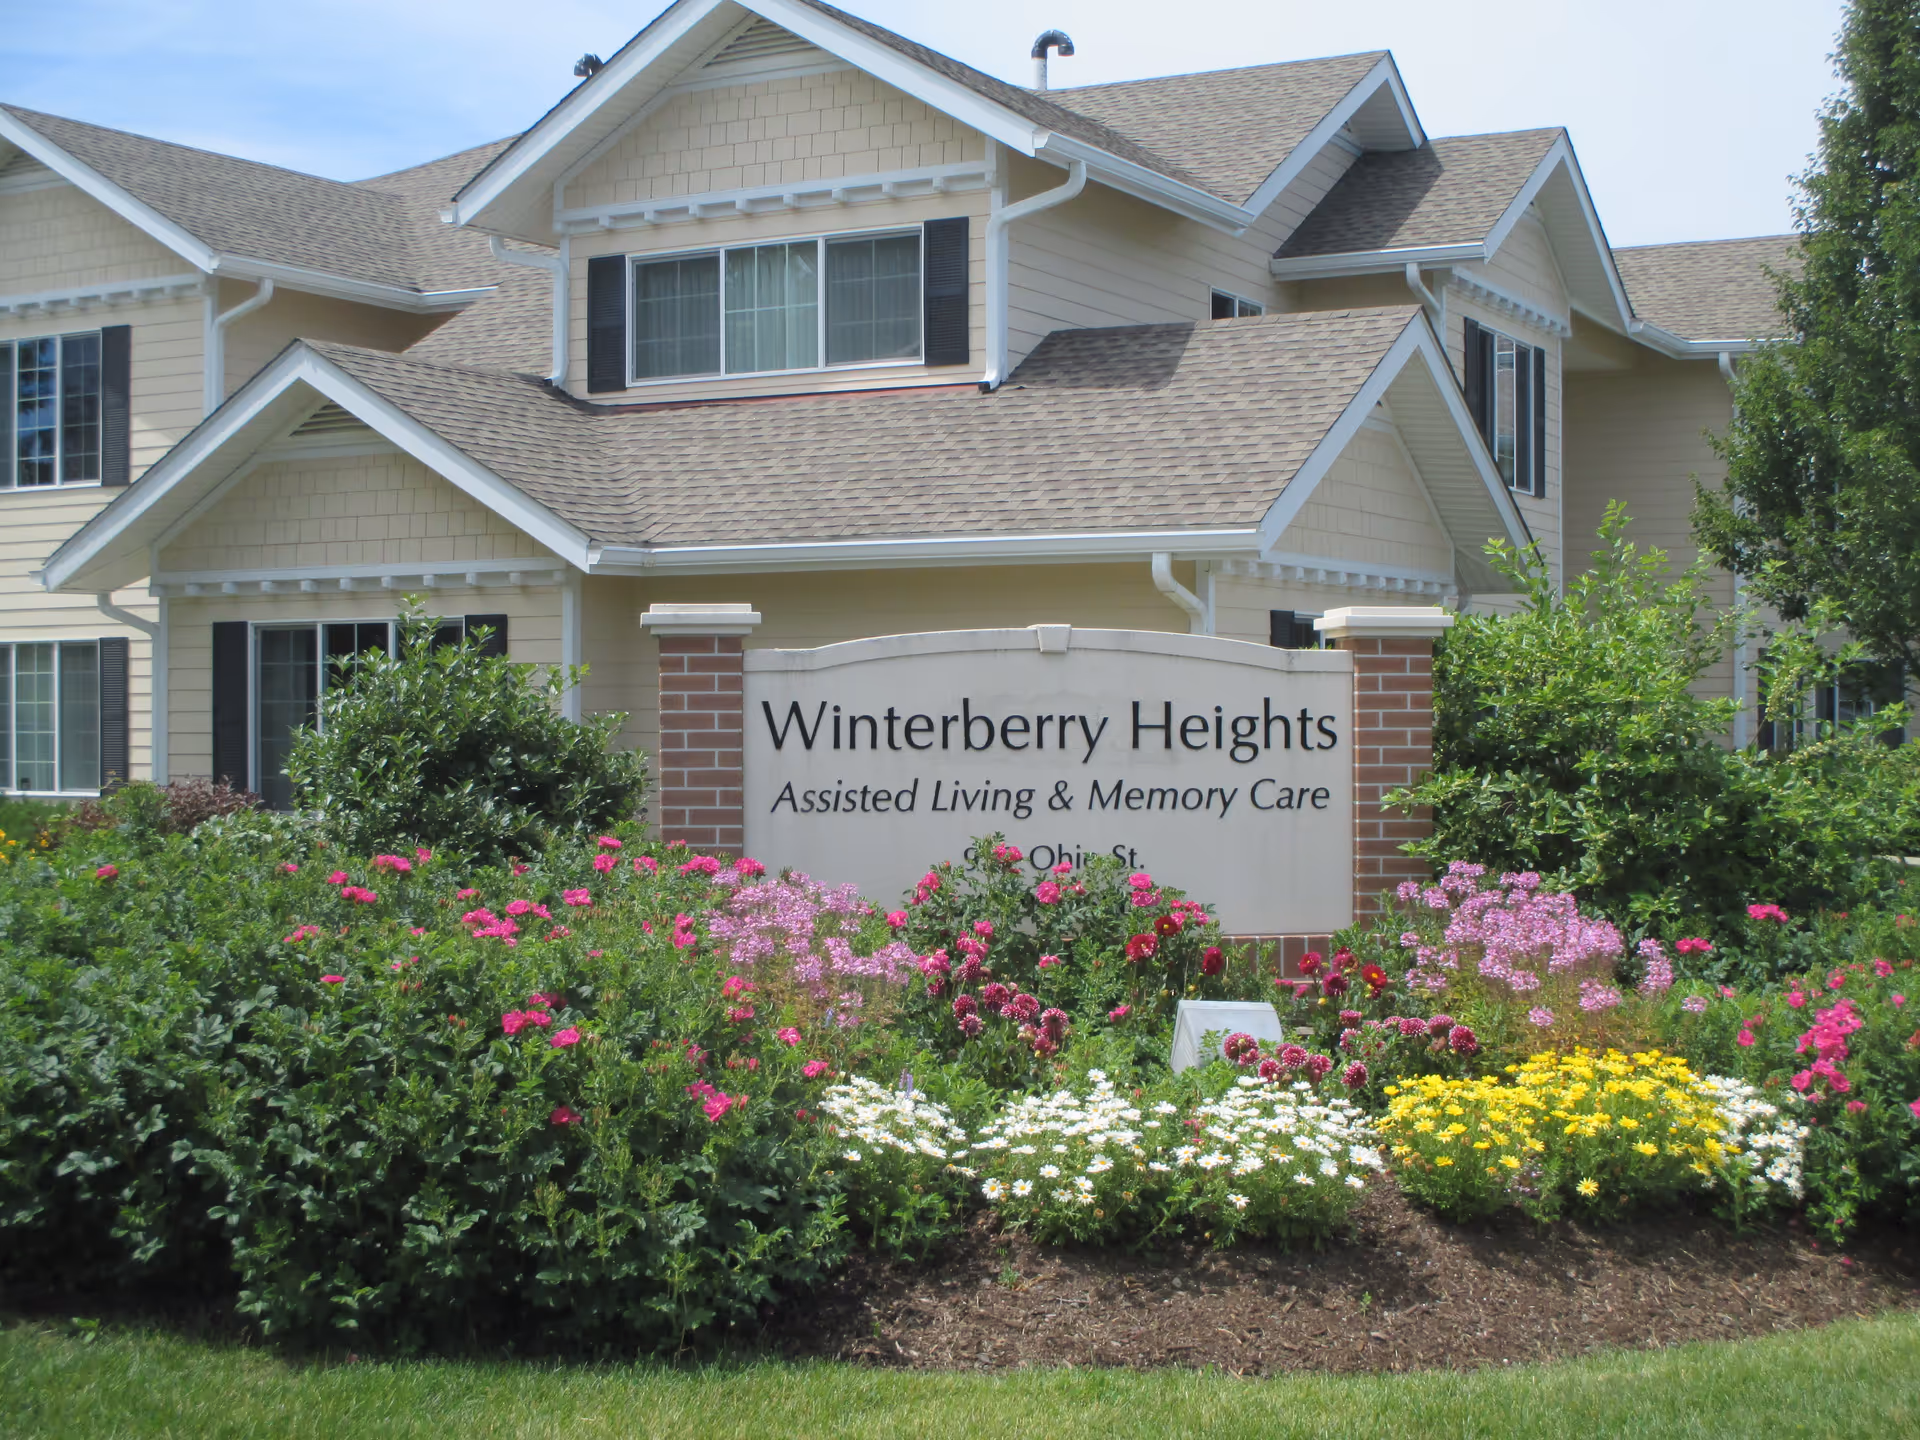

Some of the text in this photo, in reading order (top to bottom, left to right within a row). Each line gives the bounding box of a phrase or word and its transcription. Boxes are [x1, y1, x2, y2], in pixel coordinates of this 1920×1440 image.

[761, 697, 1338, 764] Winterberry Heights
[770, 777, 1330, 820] Assisted Living & Memory Care
[1112, 844, 1145, 870] St.
